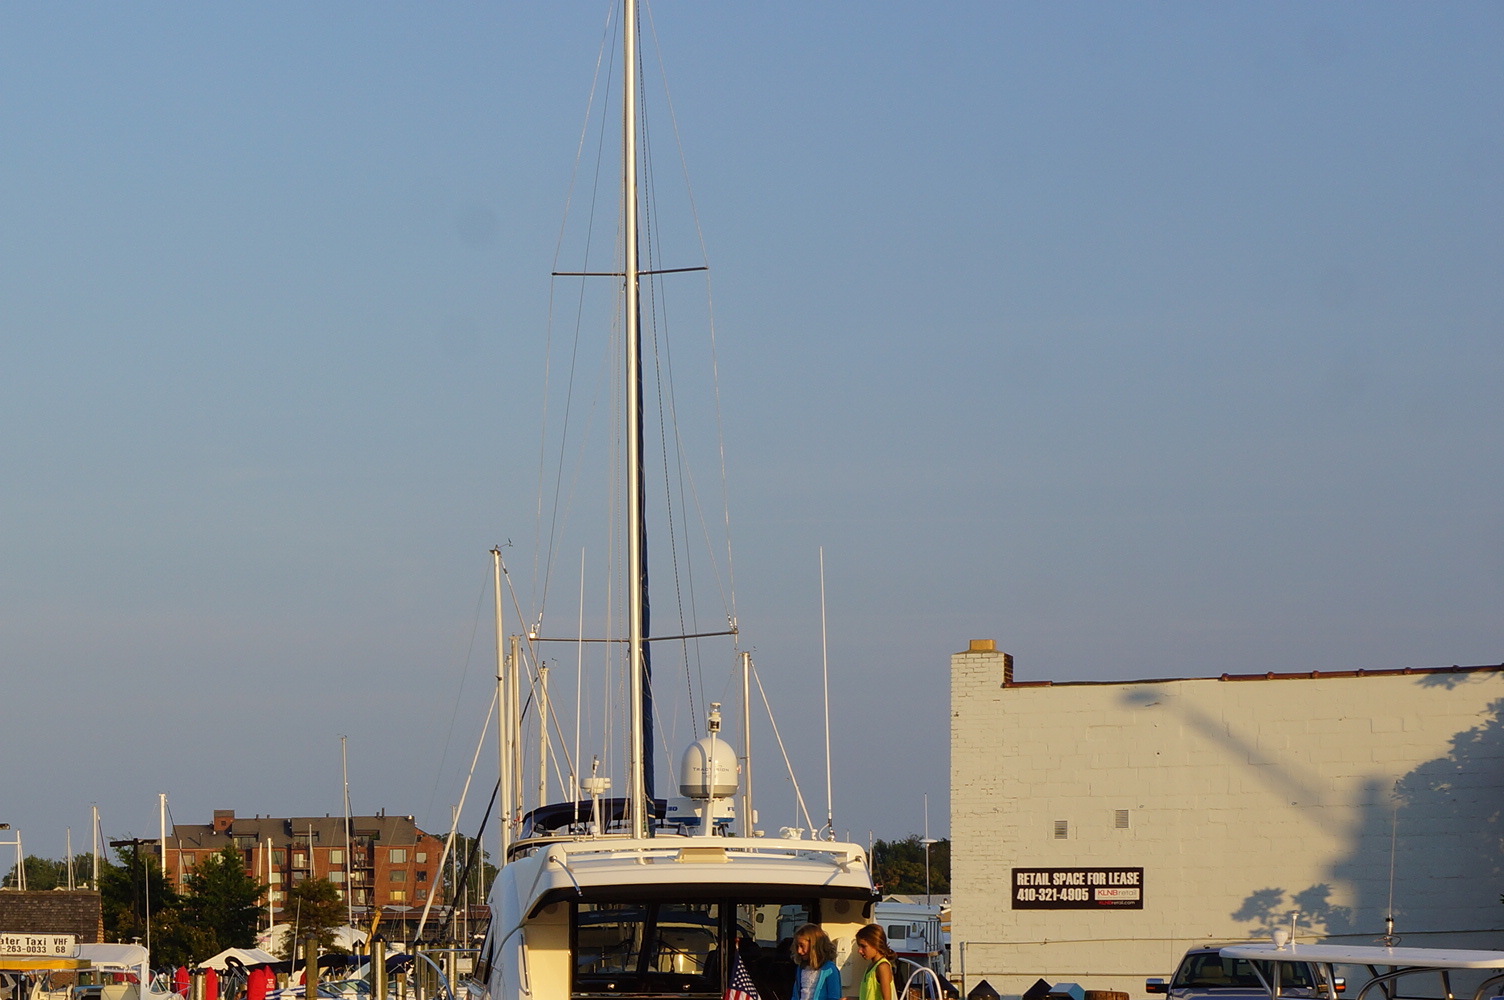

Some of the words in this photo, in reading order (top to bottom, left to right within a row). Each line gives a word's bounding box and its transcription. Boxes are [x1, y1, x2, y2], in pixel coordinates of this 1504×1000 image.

[1017, 872, 1051, 886] RETAIL
[1052, 872, 1085, 885] SPACE
[1087, 872, 1107, 885] FOR
[1108, 871, 1140, 885] LEASE
[1016, 888, 1089, 901] 410-321-4905
[25, 937, 47, 946] Taxi
[53, 938, 68, 946] VHF
[55, 945, 66, 954] 68
